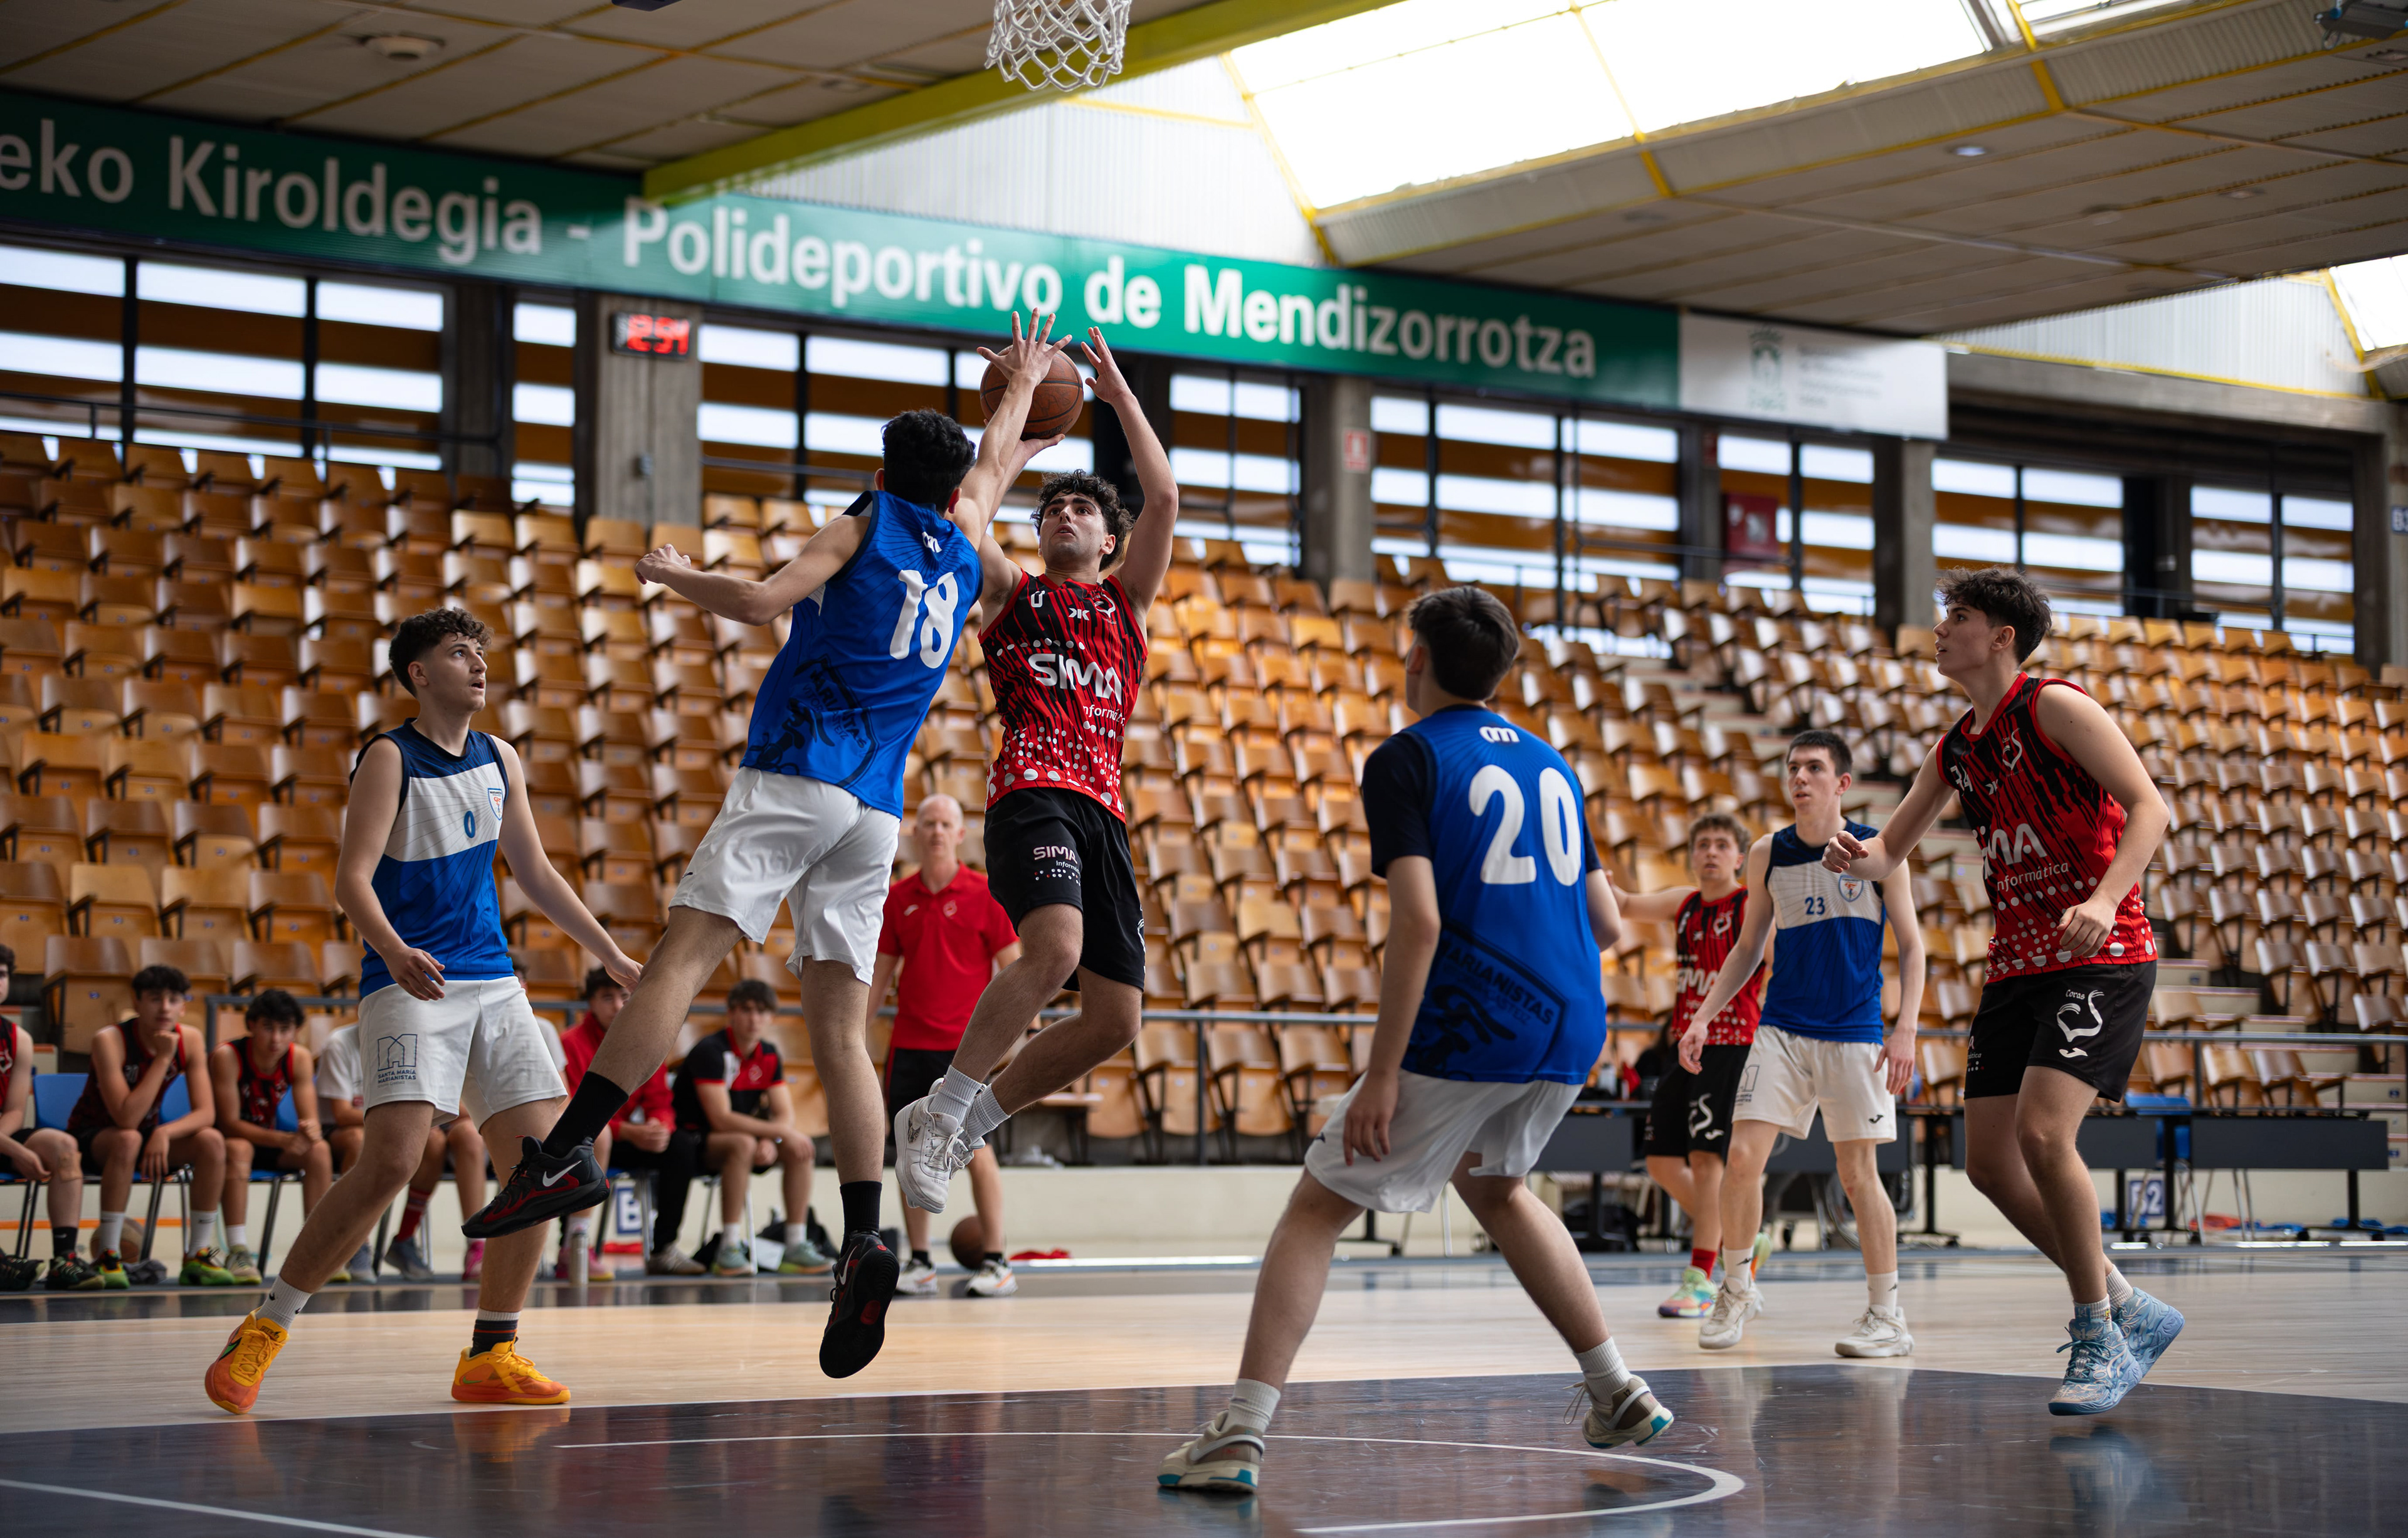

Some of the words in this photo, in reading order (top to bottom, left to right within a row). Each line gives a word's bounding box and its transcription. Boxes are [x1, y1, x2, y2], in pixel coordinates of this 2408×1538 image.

[168, 134, 542, 265] Kiroldegia
[623, 195, 1064, 313] Polideportivo
[1084, 256, 1163, 329] de
[1184, 263, 1597, 377] Mendizorrotza
[889, 569, 959, 669] 18
[1028, 653, 1122, 706] SIMA
[463, 810, 476, 839] 0
[1468, 764, 1582, 887] 20
[1033, 845, 1078, 865] SIMA
[1997, 862, 2069, 892] nformática
[1805, 897, 1825, 915] 23
[2065, 989, 2085, 1000] Coras
[378, 1071, 395, 1079] SANTA
[378, 1075, 417, 1084] MARIANISTAS
